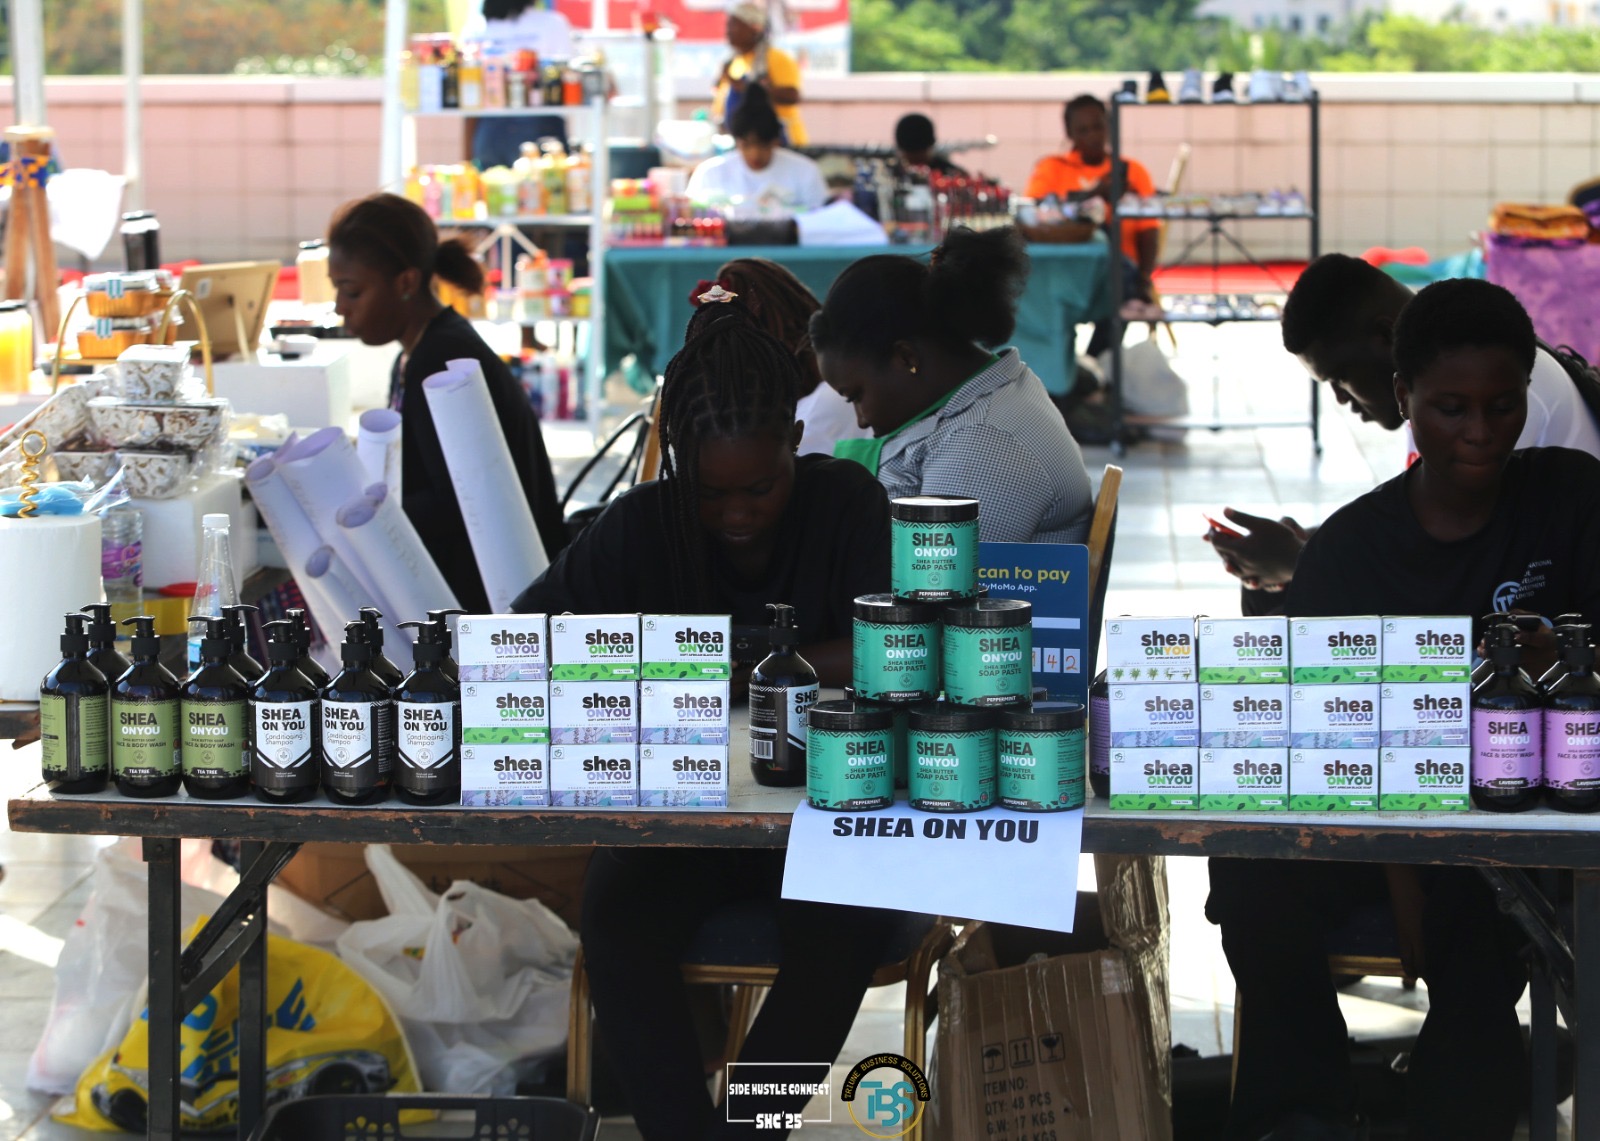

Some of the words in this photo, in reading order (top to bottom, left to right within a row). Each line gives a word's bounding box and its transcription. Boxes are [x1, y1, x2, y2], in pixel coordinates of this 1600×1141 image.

[912, 532, 955, 546] SHEA
[914, 548, 958, 557] ONYOU
[1014, 566, 1032, 579] to
[1038, 570, 1070, 584] pay
[1017, 584, 1038, 592] App.
[490, 630, 540, 646] shea
[585, 629, 634, 644] shea
[675, 628, 724, 644] shea
[884, 634, 926, 648] SHEA
[1141, 631, 1190, 646] shea
[1233, 632, 1282, 648] shea
[1328, 632, 1376, 647] shea
[1416, 630, 1464, 646] shea
[495, 645, 540, 654] ONYOU
[589, 645, 634, 654] ONYOU
[678, 644, 724, 652] ONYOU
[979, 637, 1020, 652] SHEA
[886, 648, 928, 658] ONYOU
[982, 652, 1022, 662] ONYOU
[1145, 647, 1190, 656] ONYOU
[1237, 648, 1282, 657] ONYOU
[1332, 647, 1376, 656] ONYOU
[1419, 646, 1464, 656] ONYOU
[496, 693, 544, 708] shea
[582, 693, 631, 708] shea
[673, 693, 722, 709] shea
[1145, 696, 1194, 712] shea
[1233, 696, 1282, 712] shea
[1324, 697, 1373, 713] shea
[1413, 694, 1462, 710] shea
[120, 712, 157, 725] SHEA
[188, 712, 226, 725] SHEA
[261, 708, 301, 720] SHEA
[325, 707, 360, 720] SHEA
[404, 709, 443, 720] SHEA
[500, 709, 544, 718] ONYOU
[586, 709, 631, 718] ONYOU
[677, 709, 722, 718] ONYOU
[1148, 712, 1194, 721] ONYOU
[1237, 712, 1282, 721] ONYOU
[1328, 713, 1373, 722] ONYOU
[1417, 710, 1463, 719] ONYOU
[122, 726, 160, 735] ONYOU
[190, 726, 229, 735] ONYOU
[262, 721, 278, 730] ON
[282, 721, 305, 730] YOU
[325, 720, 337, 730] ON
[340, 722, 364, 730] YOU
[404, 722, 420, 731] ON
[423, 722, 447, 731] YOU
[1488, 721, 1528, 735] SHEA
[1490, 736, 1530, 744] ONYOU
[845, 740, 885, 755] SHEA
[917, 741, 956, 756] SHEA
[1000, 740, 1033, 756] SHEA
[494, 756, 542, 771] shea
[583, 756, 631, 771] shea
[672, 756, 721, 771] shea
[848, 754, 887, 766] ONYOU
[918, 757, 959, 767] ONYOU
[1001, 755, 1036, 766] ONYOU
[1144, 760, 1192, 776] shea
[1233, 759, 1282, 775] shea
[1324, 760, 1372, 776] shea
[1415, 759, 1463, 775] shea
[498, 772, 542, 780] ONYOU
[587, 772, 631, 780] ONYOU
[676, 772, 721, 780] ONYOU
[868, 771, 886, 779] PASTE
[1147, 776, 1192, 785] ONYOU
[1237, 776, 1282, 785] ONYOU
[1327, 776, 1372, 785] ONYOU
[1418, 775, 1464, 784] ONYOU
[833, 816, 914, 838] SHEA
[923, 818, 967, 839] ON
[976, 819, 1039, 843] YOU
[983, 1080, 1007, 1096] ITEM
[1029, 1092, 1051, 1108] PCS
[1015, 1115, 1026, 1129] 17
[1032, 1110, 1055, 1127] KGS
